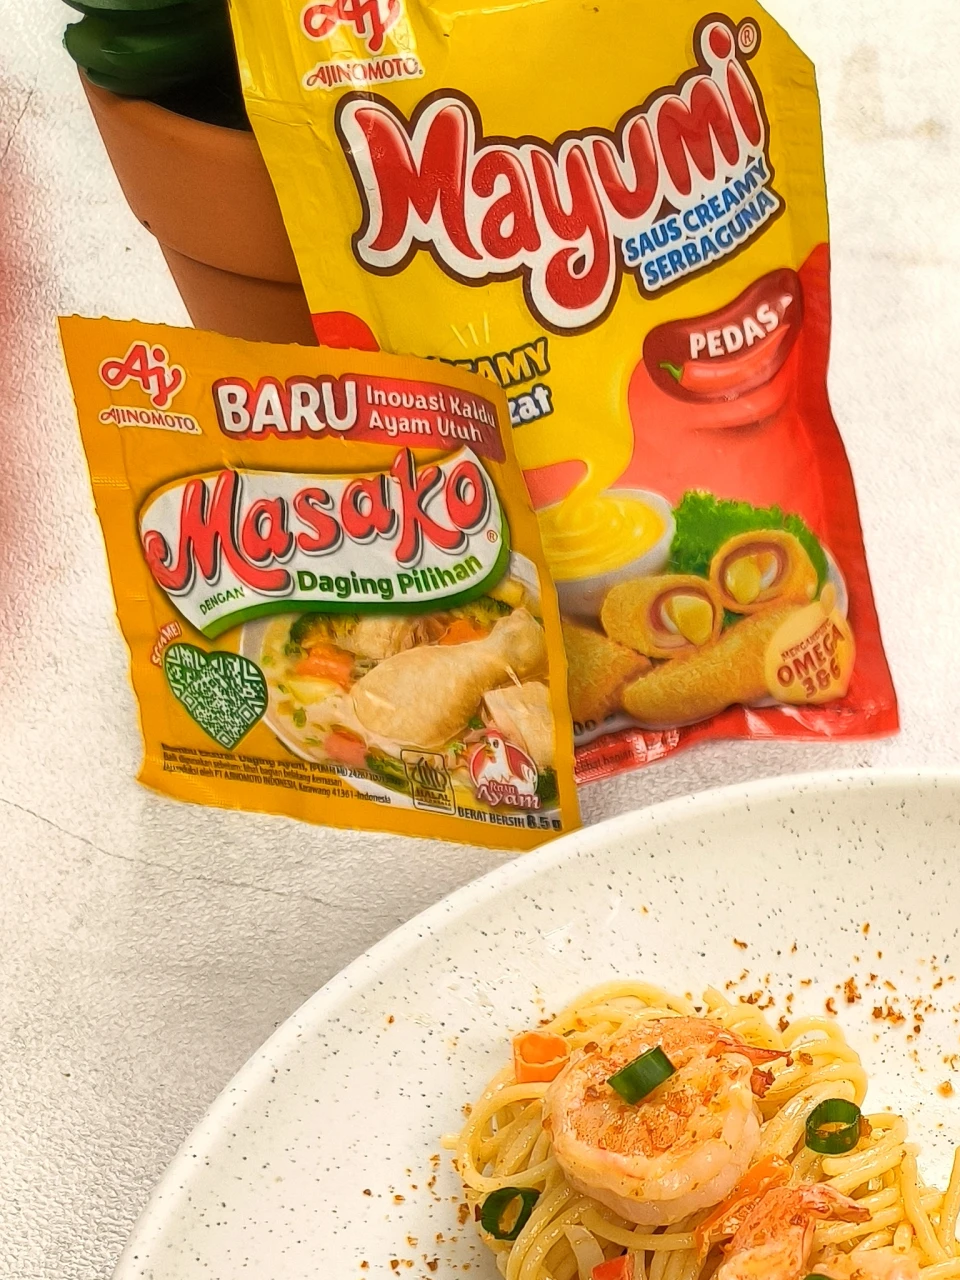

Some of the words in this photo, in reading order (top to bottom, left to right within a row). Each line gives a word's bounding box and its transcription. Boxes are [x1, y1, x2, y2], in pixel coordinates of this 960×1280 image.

[343, 20, 764, 328] Mayumi
[625, 218, 682, 262] SAUS
[683, 156, 768, 232] CREAMY
[644, 190, 775, 286] SERBAGUNA
[689, 303, 779, 359] PEDAS
[452, 339, 549, 387] AMY
[217, 380, 358, 434] BARU
[366, 385, 446, 412] Inovasi
[449, 395, 497, 429] Kaldu
[369, 410, 432, 437] Ayam
[437, 416, 484, 443] Utuh
[144, 447, 488, 597] Masako
[200, 586, 245, 615] DENGAN
[297, 571, 394, 600] Daging
[398, 554, 484, 595] Pilihan
[777, 623, 846, 688] OMEGA
